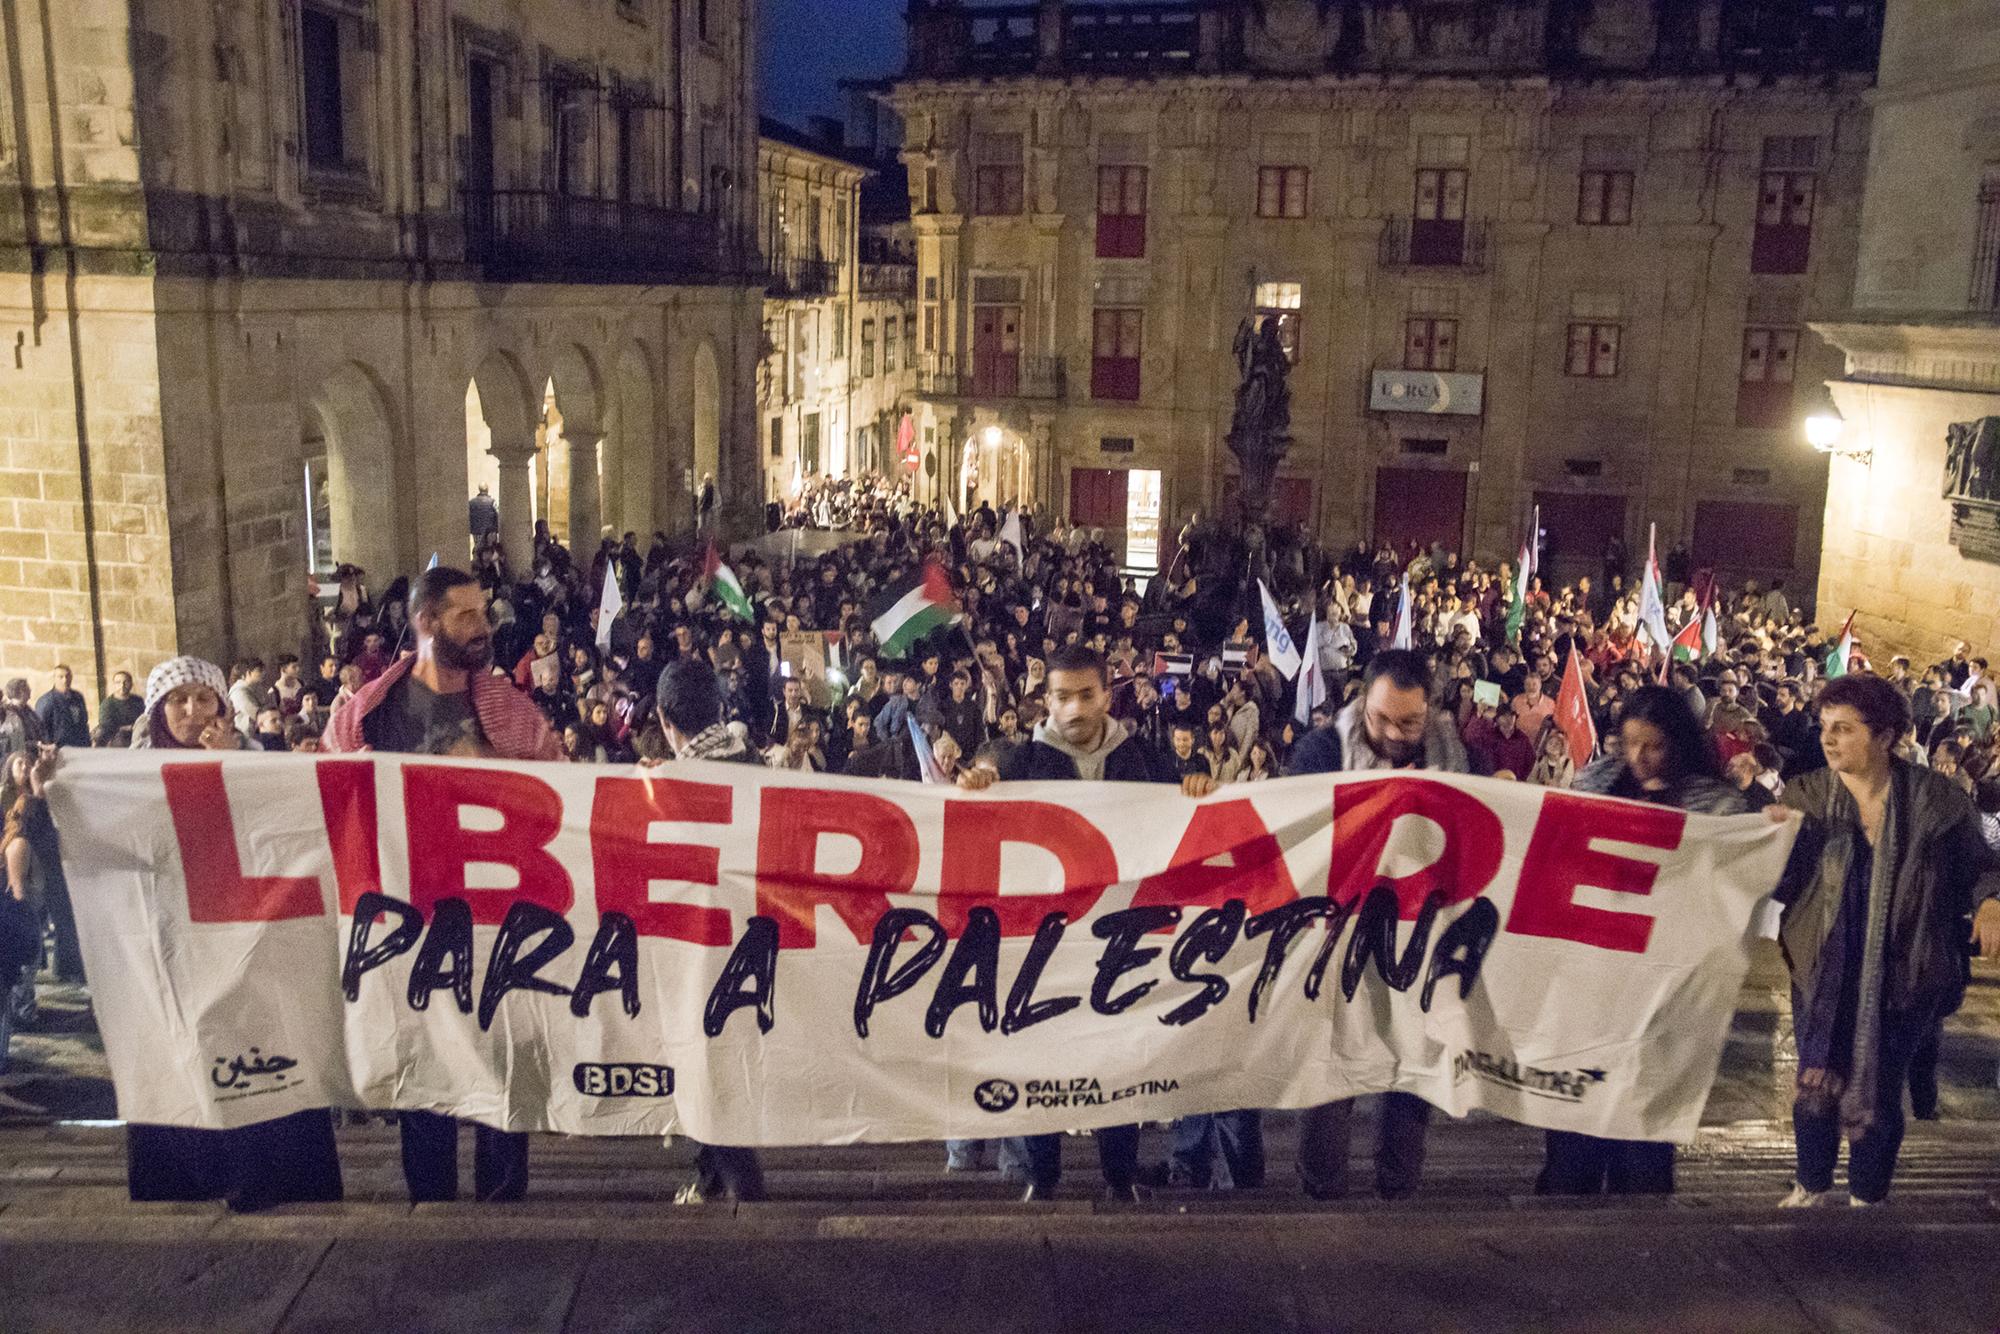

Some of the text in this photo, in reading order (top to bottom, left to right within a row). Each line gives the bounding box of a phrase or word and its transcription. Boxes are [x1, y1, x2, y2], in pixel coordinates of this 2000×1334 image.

[162, 760, 1686, 953] LIBERDADE
[342, 878, 1499, 1039] PARA A PALESTINA
[211, 1046, 298, 1089] جنين
[583, 1065, 669, 1095] BDS!
[1025, 1078, 1101, 1094] GALIZA
[1026, 1079, 1180, 1108] POR PALESTINA
